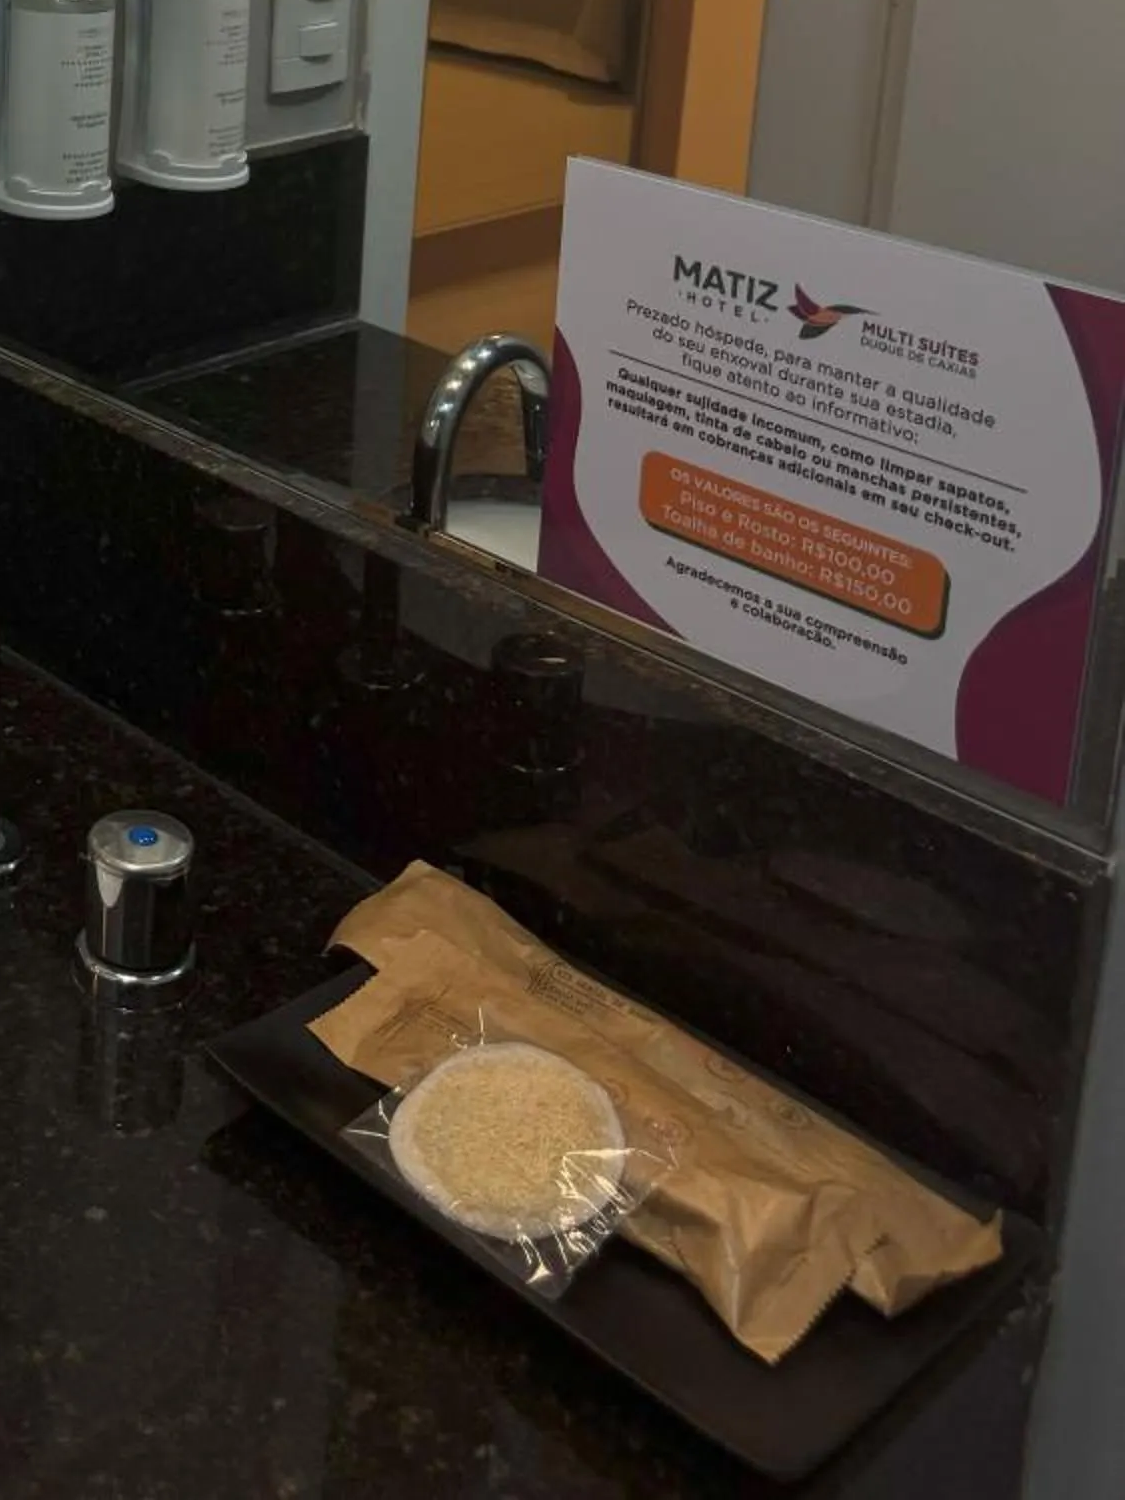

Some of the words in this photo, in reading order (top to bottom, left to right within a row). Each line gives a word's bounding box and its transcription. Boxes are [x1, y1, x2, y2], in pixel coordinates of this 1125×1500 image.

[674, 254, 779, 311] MATIZ
[686, 291, 760, 323] HOTEL
[626, 299, 690, 331] Prezado
[694, 321, 768, 358] hóspede,
[774, 349, 812, 372] para
[818, 360, 879, 391] manter
[885, 384, 896, 397] a
[902, 389, 996, 429] qualidade
[652, 327, 674, 343] do
[678, 336, 705, 354] seu
[710, 347, 772, 376] enxoval
[778, 368, 844, 399] durante
[851, 391, 881, 411] sua
[860, 335, 904, 358] DUQUE
[907, 349, 925, 363] DE
[928, 356, 977, 379] CAXIAS
[862, 320, 914, 346] MULTI
[918, 336, 980, 366] SUÍTES
[681, 352, 722, 378] fique
[726, 370, 780, 398] atento
[785, 391, 806, 405] ao
[606, 380, 690, 421] maquiagem,
[695, 410, 729, 433] tinta
[732, 424, 752, 440] de
[756, 433, 807, 460] cabelo
[812, 454, 832, 469] ou
[836, 462, 906, 496] manchas
[910, 489, 1022, 539] persistentes,
[618, 367, 682, 399] Qualquer
[685, 391, 748, 422] sujidade
[751, 413, 825, 452] incomum,
[831, 442, 875, 466] como
[880, 457, 934, 486] limpar
[938, 479, 1011, 515] sapatos,
[608, 397, 669, 427] resultará
[672, 421, 695, 437] em
[698, 431, 774, 466] cobranças
[778, 458, 856, 496] adicionais
[861, 488, 886, 507] em
[890, 499, 919, 518] seu
[924, 509, 1015, 552] check-out.
[669, 467, 690, 485] OS
[694, 477, 761, 511] VALORES
[764, 501, 796, 524] SÃO
[798, 517, 820, 534] OS
[660, 504, 718, 537] Toalha
[722, 531, 746, 549] de
[679, 490, 716, 516] Piso
[721, 509, 734, 523] e
[738, 513, 796, 546] Rosto:
[666, 555, 760, 605] Agradecemos
[764, 597, 773, 609] a
[777, 603, 802, 622] sua
[805, 615, 908, 665] compreensão
[730, 597, 739, 609] e
